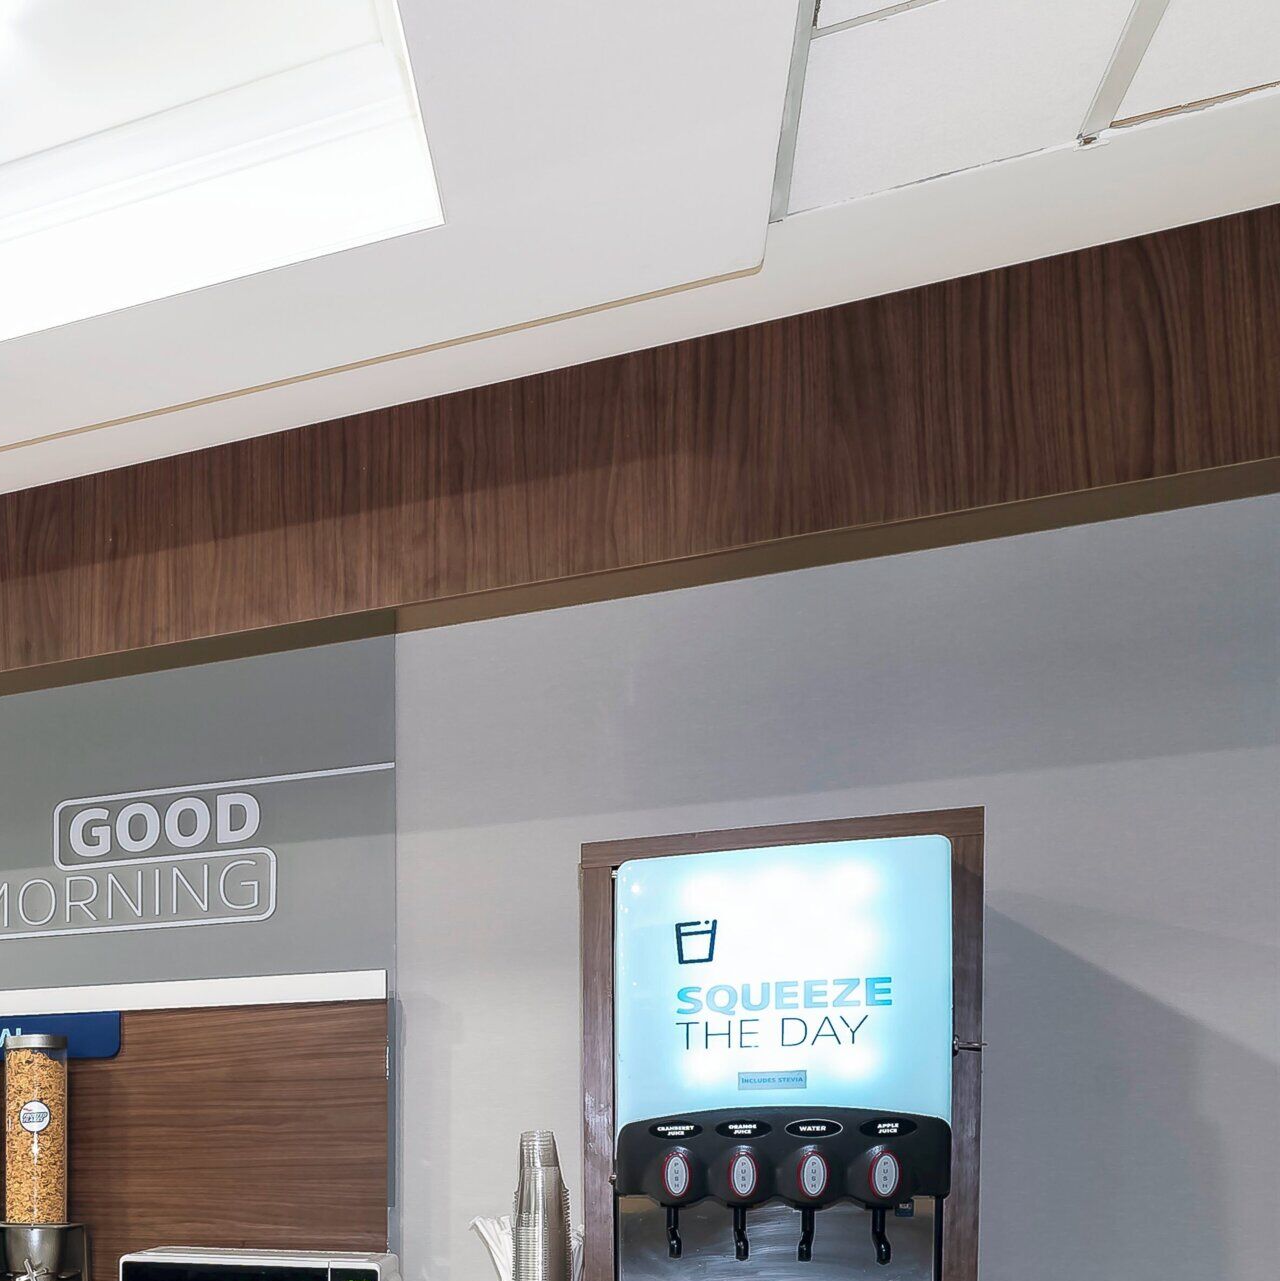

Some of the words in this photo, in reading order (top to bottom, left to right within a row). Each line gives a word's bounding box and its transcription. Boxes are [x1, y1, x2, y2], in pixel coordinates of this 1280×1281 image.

[69, 792, 260, 857] GOOD
[676, 977, 893, 1015] SQUEEZE
[675, 1018, 759, 1050] THE
[781, 1014, 868, 1047] DAY
